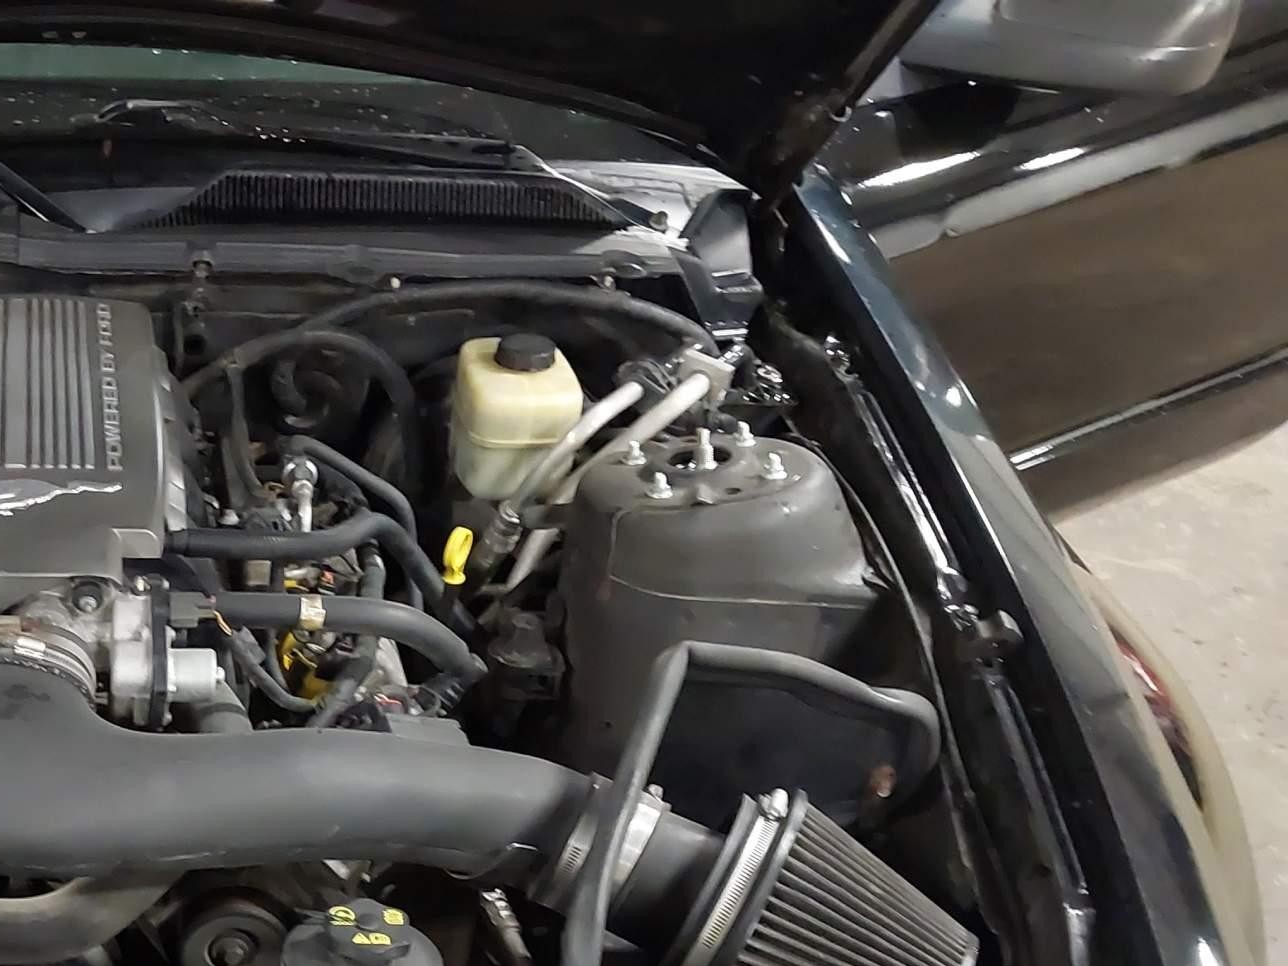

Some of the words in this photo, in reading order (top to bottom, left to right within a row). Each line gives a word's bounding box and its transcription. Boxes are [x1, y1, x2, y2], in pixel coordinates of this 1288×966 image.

[96, 303, 113, 346] FORD
[100, 350, 116, 373] BY
[101, 376, 123, 471] POWERED
